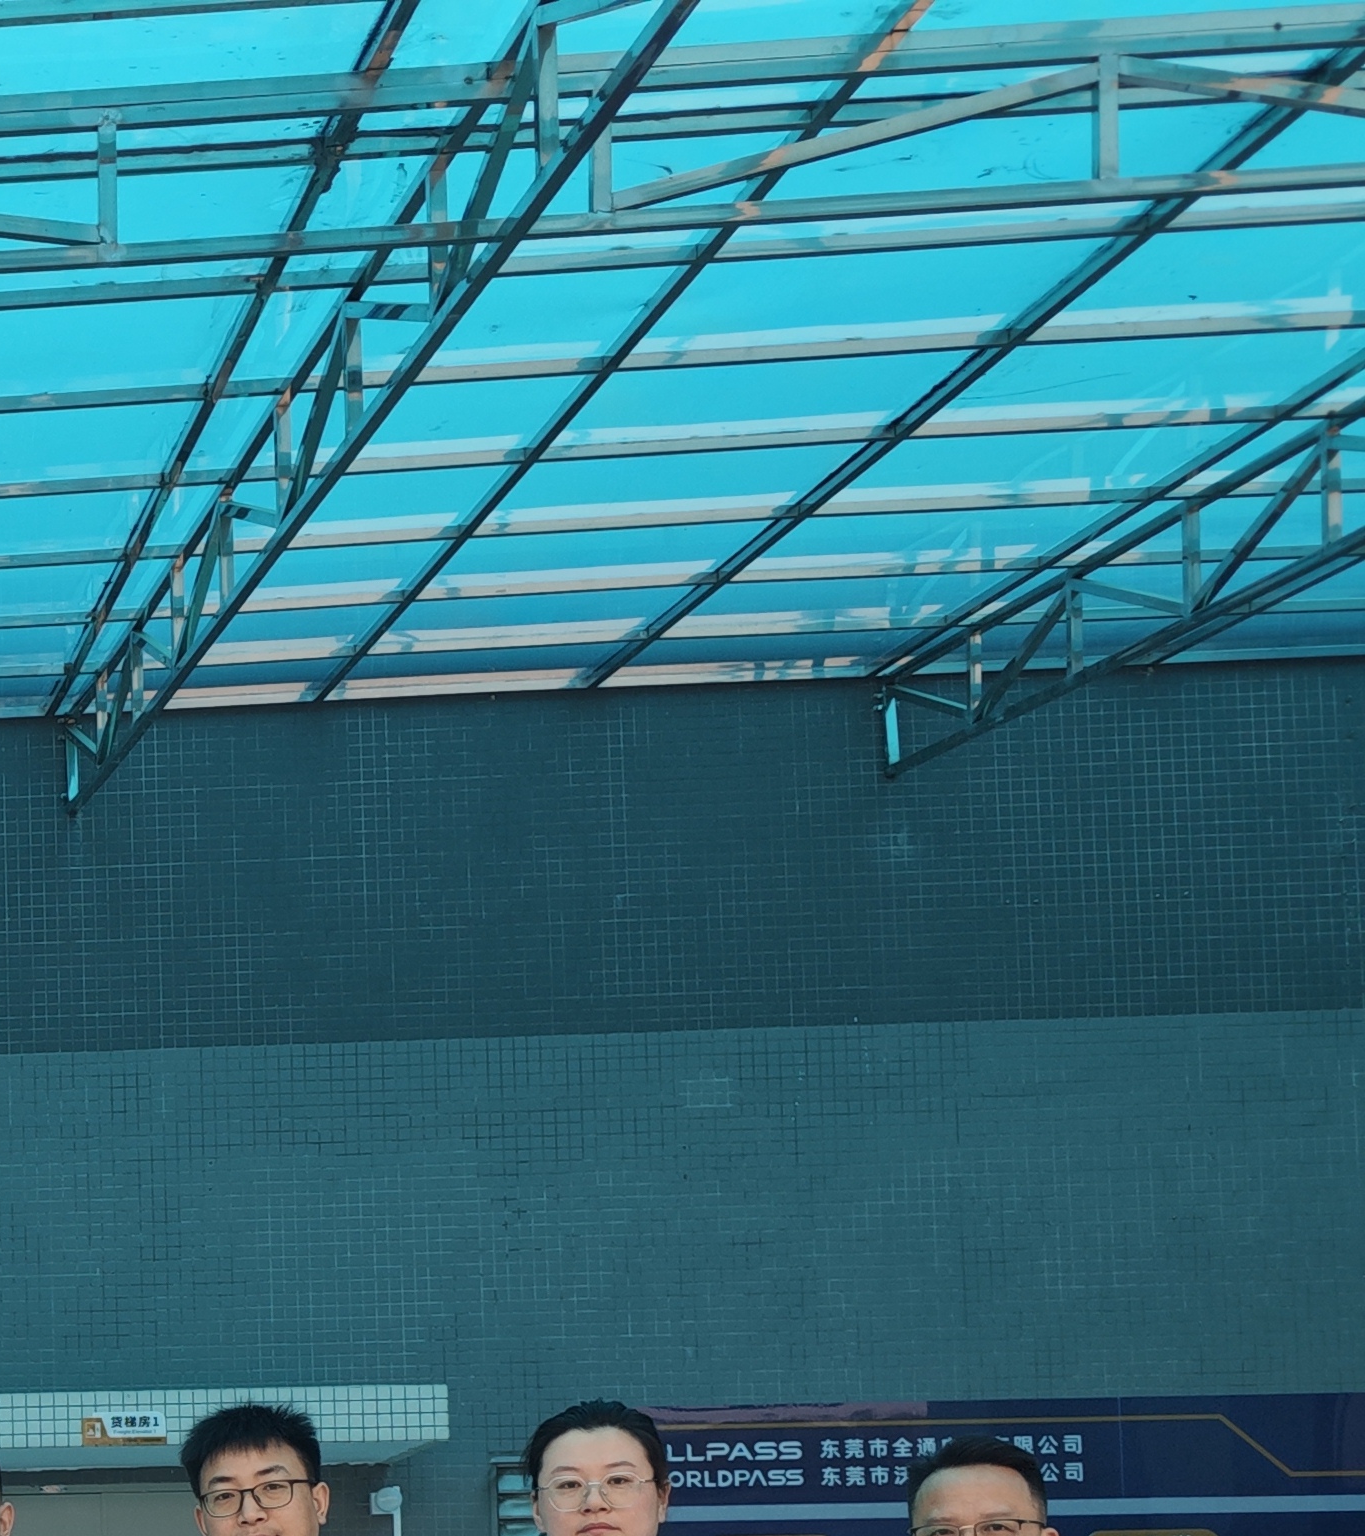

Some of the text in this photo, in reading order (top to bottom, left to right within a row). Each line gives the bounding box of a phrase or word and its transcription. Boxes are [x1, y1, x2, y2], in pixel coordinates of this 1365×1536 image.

[111, 1416, 159, 1428] 货梯房1
[666, 1440, 803, 1462] LLPASS
[668, 1468, 805, 1488] ORLDPASS
